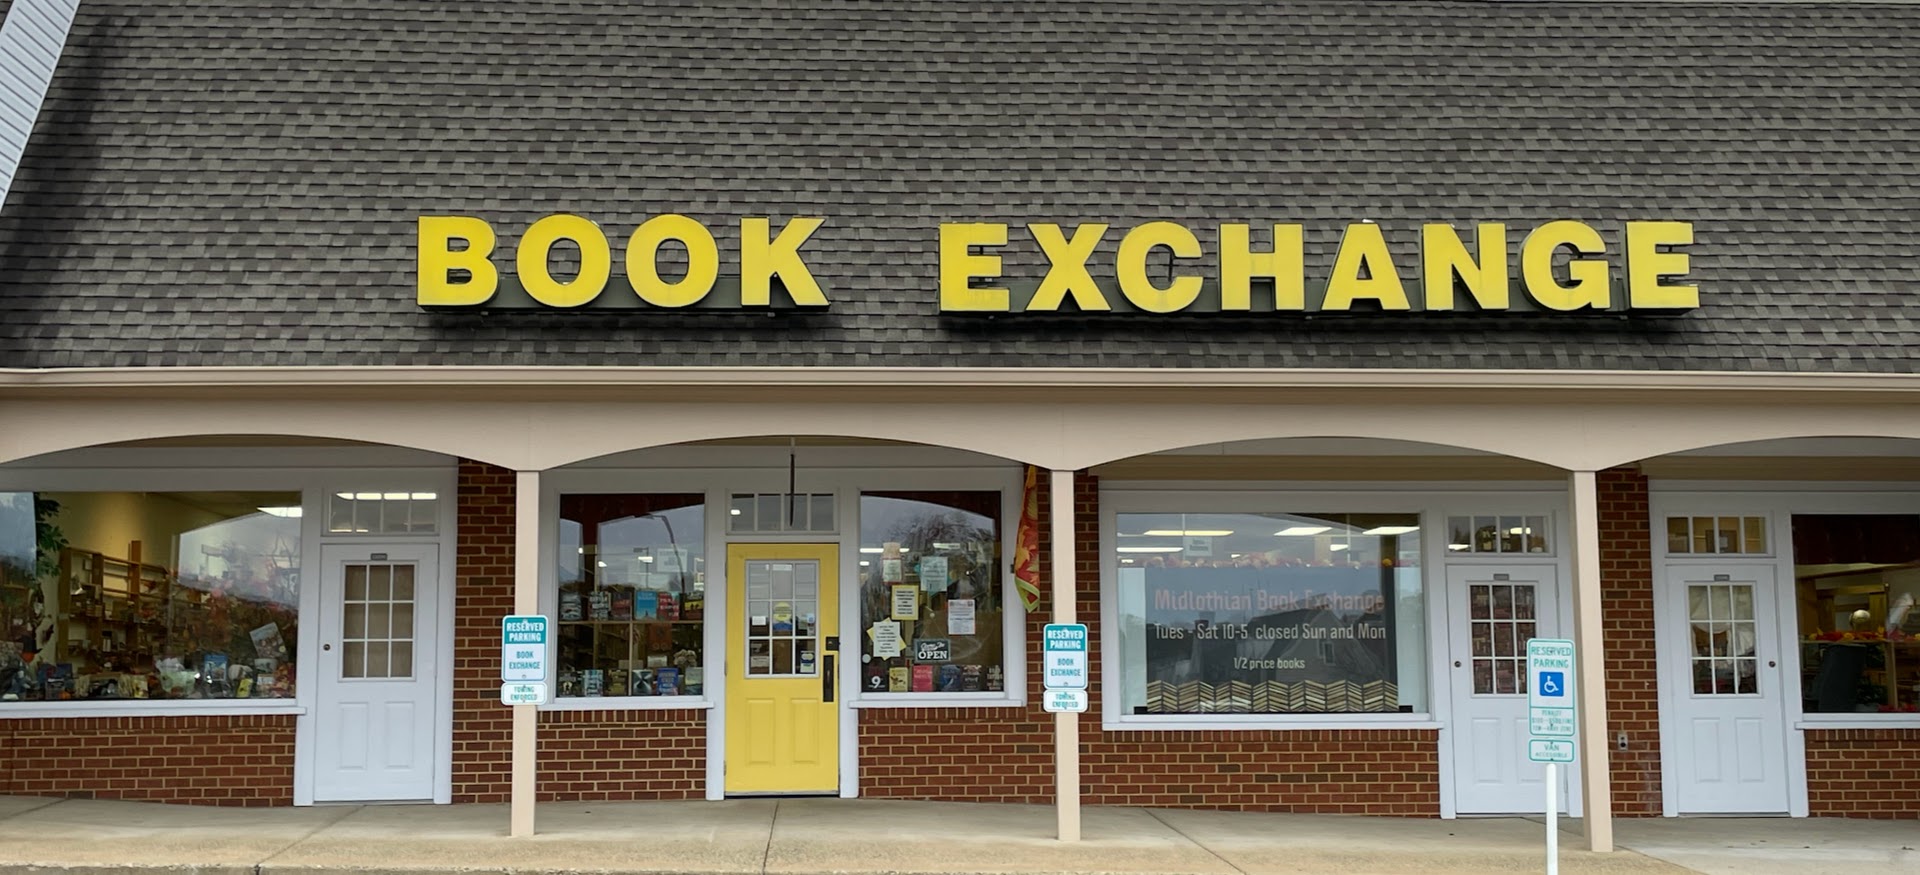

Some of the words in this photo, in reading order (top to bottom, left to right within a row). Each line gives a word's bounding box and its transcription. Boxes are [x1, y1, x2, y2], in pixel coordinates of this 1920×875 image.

[417, 214, 830, 309] BOOK
[939, 221, 1700, 313] EXCHANGE
[1154, 589, 1250, 611] Midlothian
[1257, 589, 1300, 611] Book
[1304, 589, 1385, 614] Exchange
[506, 622, 545, 632] RESERVED
[1155, 623, 1184, 640] Tues
[1197, 623, 1218, 640] Sat
[1223, 623, 1248, 640] 10-5
[1255, 623, 1298, 640] closed
[1302, 623, 1327, 640] Sun
[1330, 623, 1354, 640] and
[1358, 623, 1386, 640] Mon
[508, 632, 542, 642] PARKING
[1047, 630, 1084, 639] RESERVED
[1050, 640, 1081, 649] PARKING
[516, 651, 534, 659] BOOK
[918, 650, 947, 659] OPEN
[1530, 646, 1571, 656] RESERVED
[509, 661, 540, 670] EXCHANGE
[1057, 658, 1074, 666] BOOK
[1233, 657, 1248, 669] 1/2
[1249, 658, 1275, 671] price
[1277, 657, 1305, 669] books
[1533, 658, 1569, 668] PARKING
[1050, 668, 1081, 676] EXCHANGE
